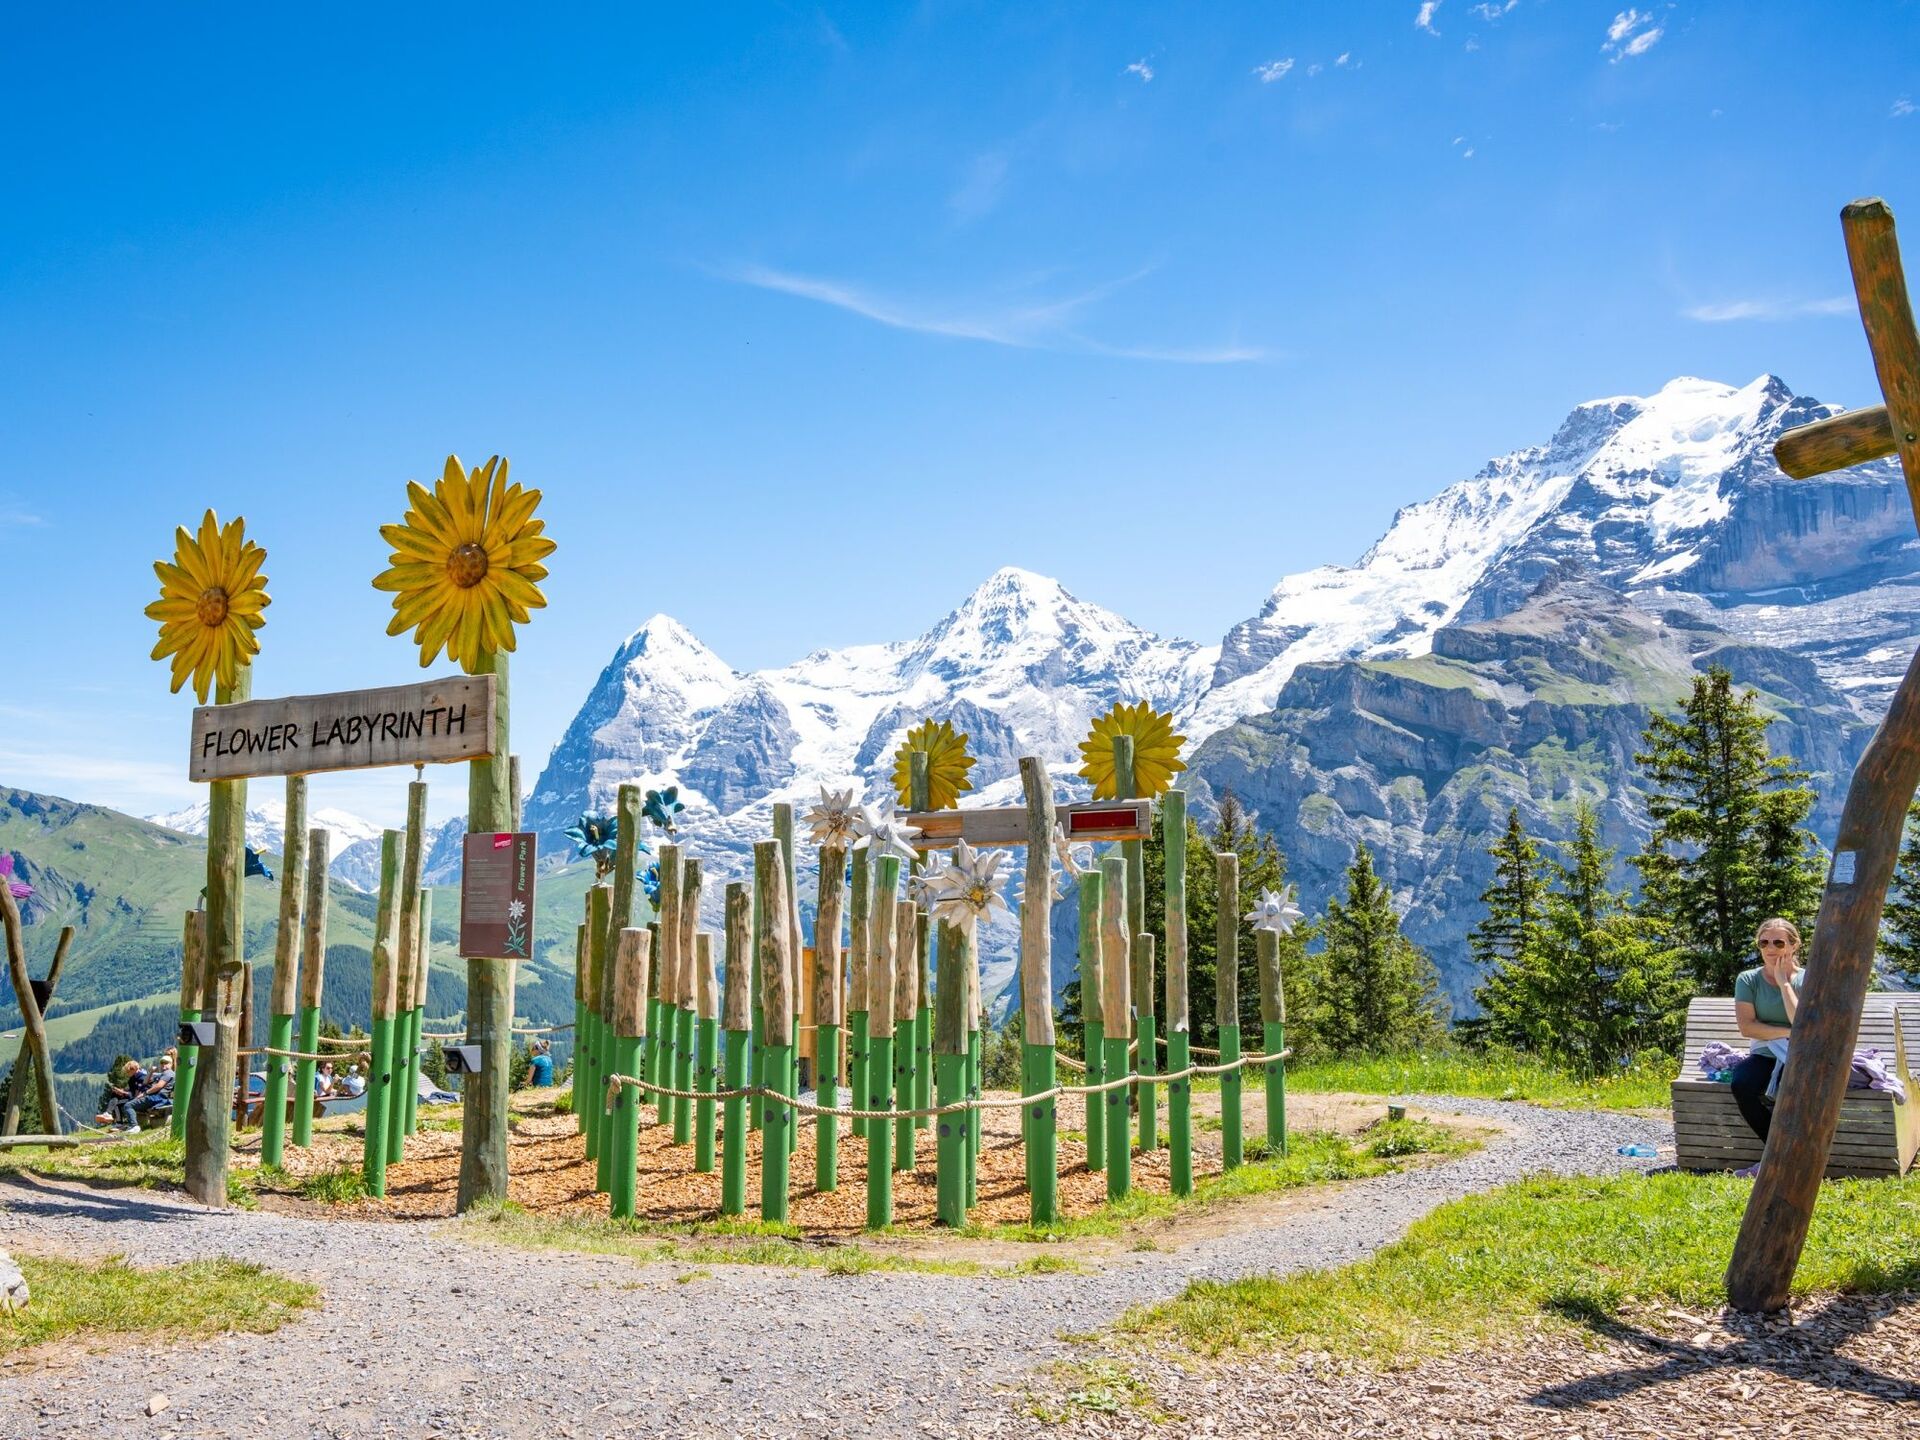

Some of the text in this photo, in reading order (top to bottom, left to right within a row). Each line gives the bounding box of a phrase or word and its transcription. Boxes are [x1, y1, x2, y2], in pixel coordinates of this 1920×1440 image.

[203, 704, 466, 758] FLOWER LABYRINTH
[517, 840, 528, 891] Flower Park
